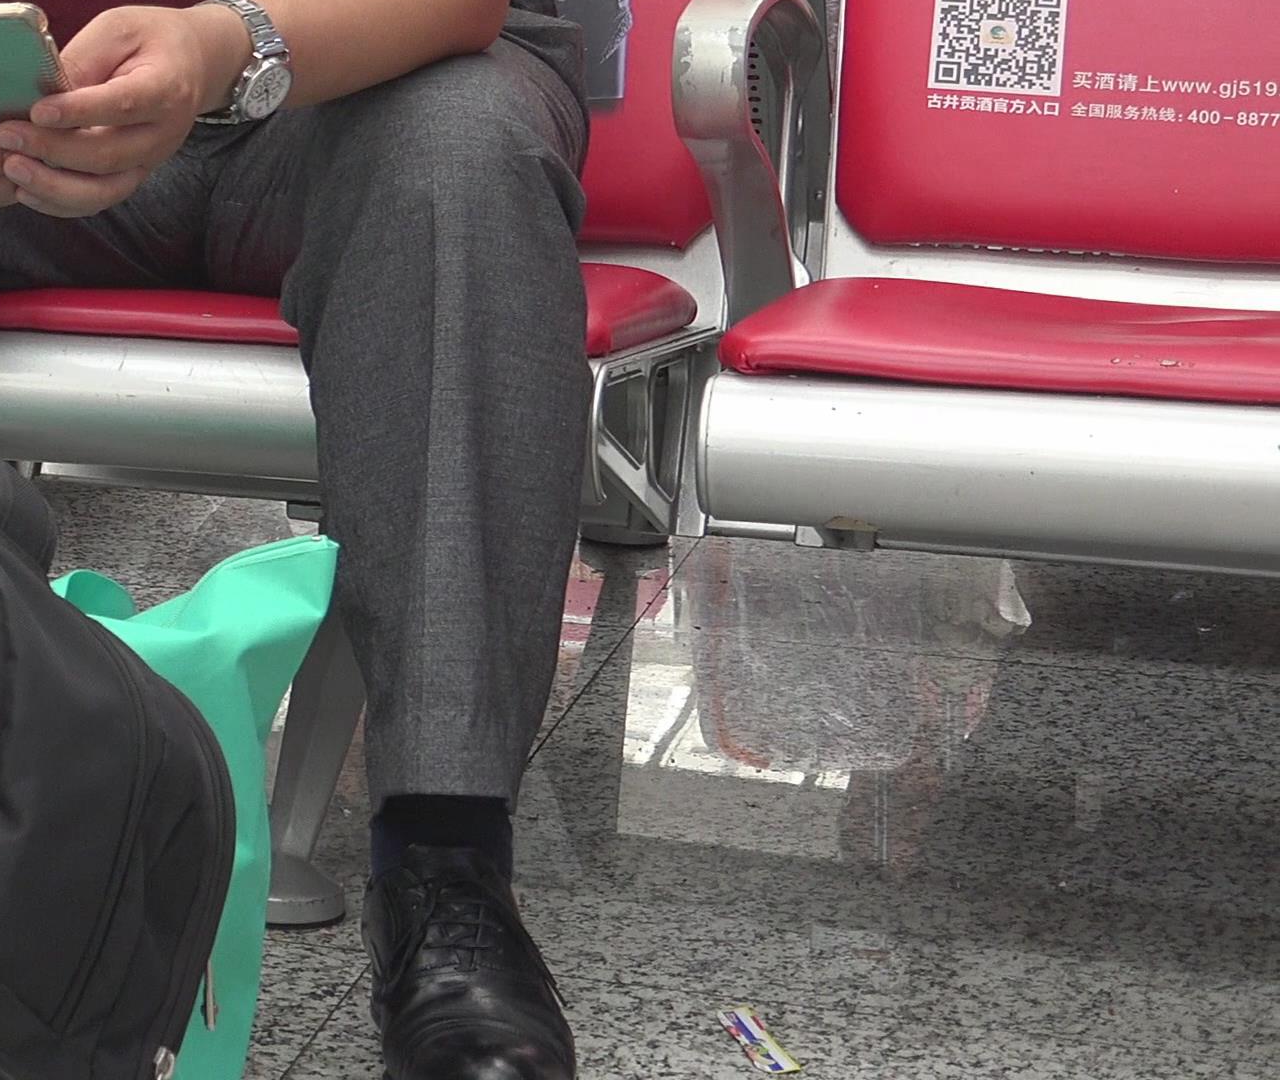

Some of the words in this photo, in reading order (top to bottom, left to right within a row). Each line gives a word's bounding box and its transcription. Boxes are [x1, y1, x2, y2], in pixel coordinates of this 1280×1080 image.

[927, 93, 1060, 117] 古井贡酒官方入口
